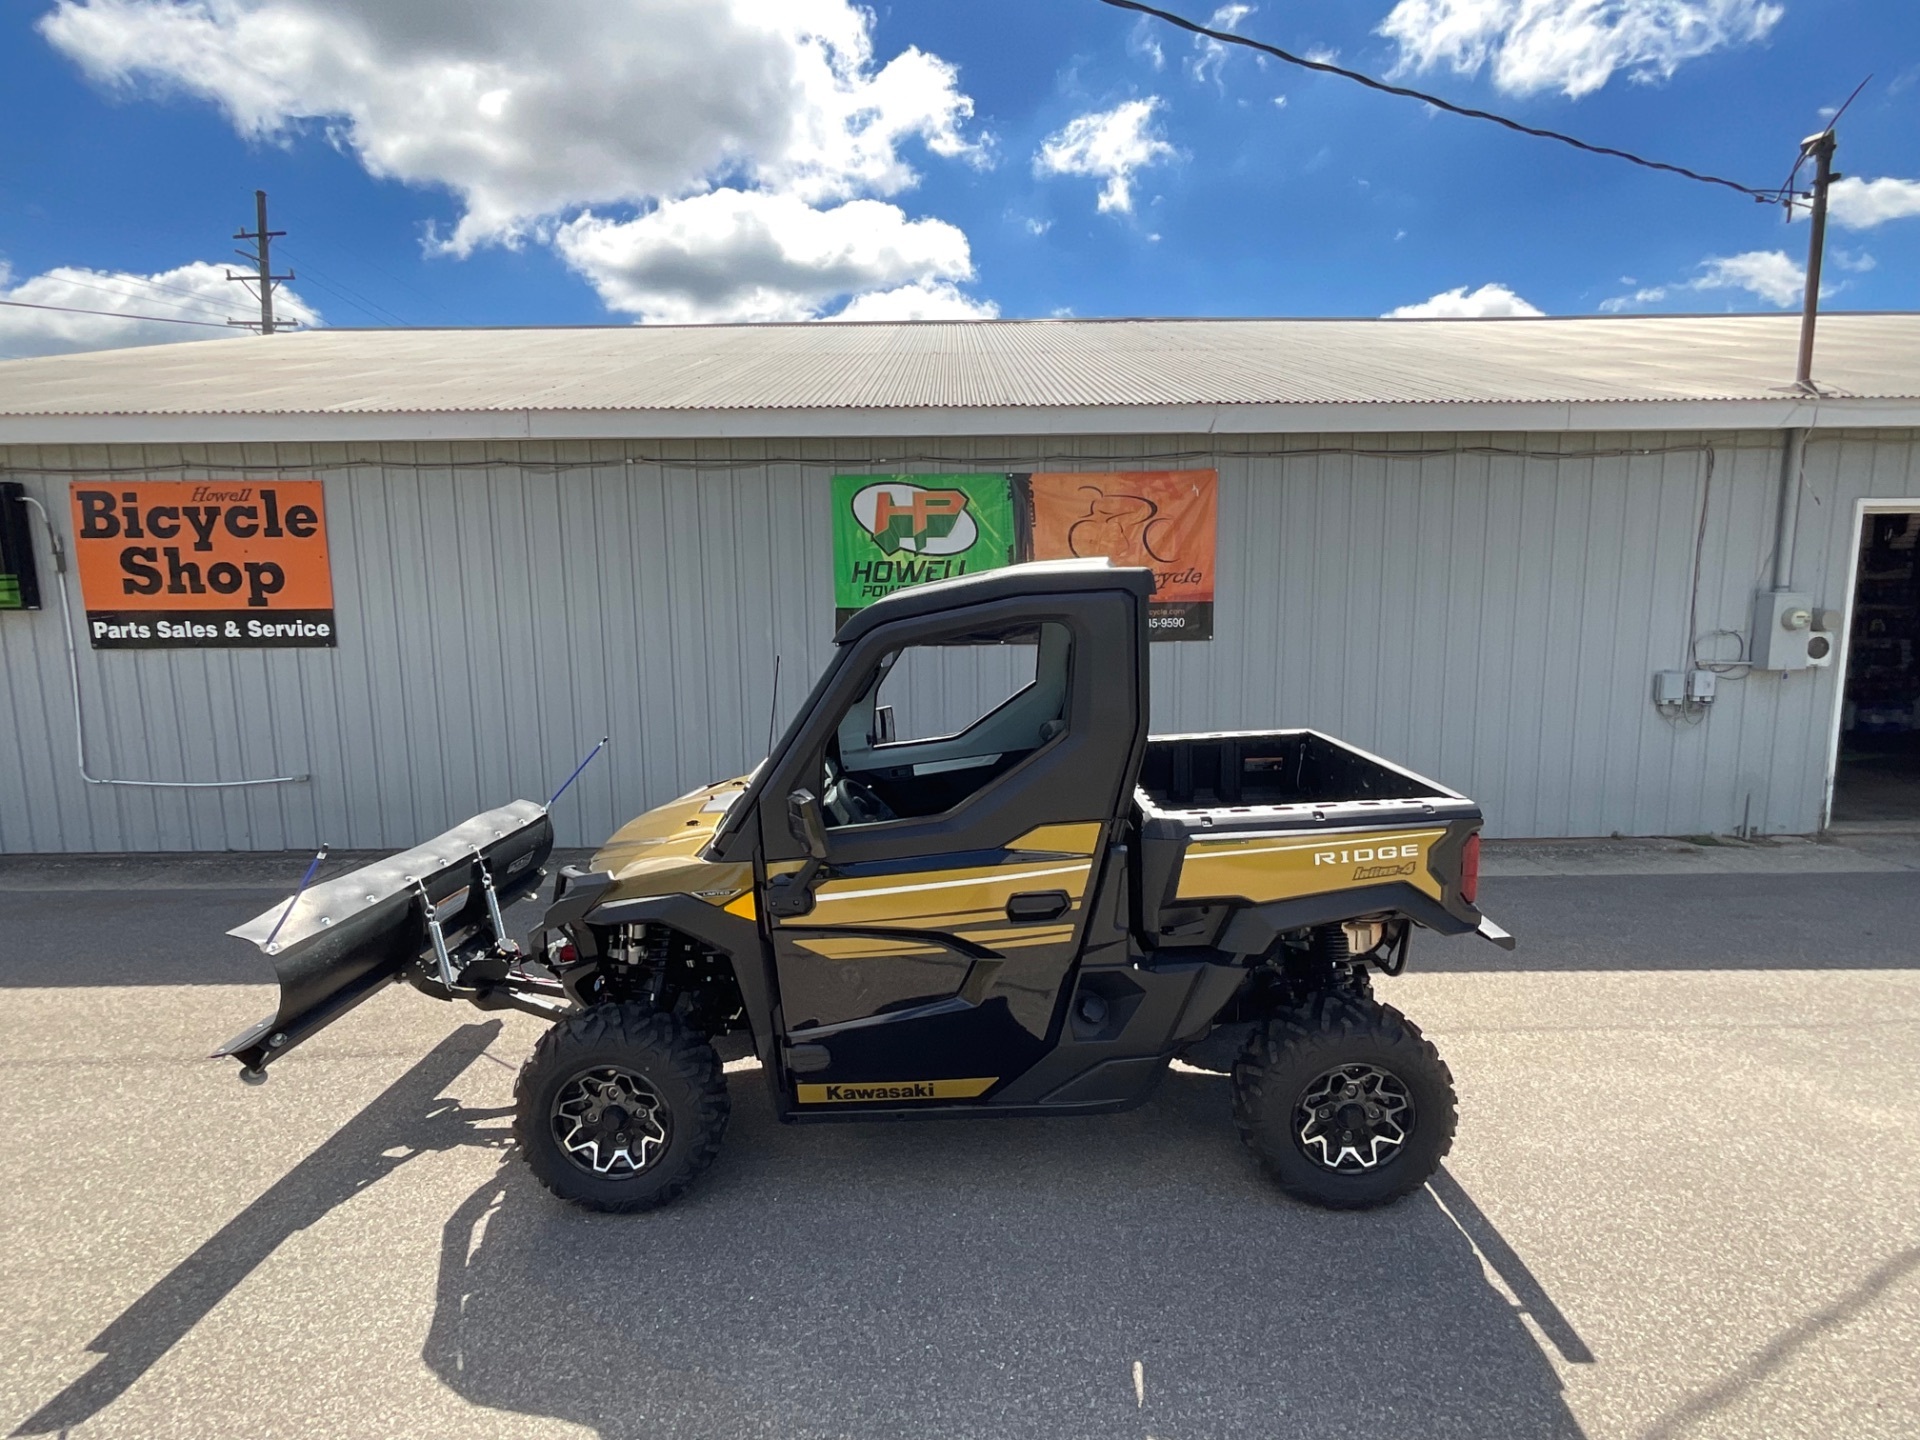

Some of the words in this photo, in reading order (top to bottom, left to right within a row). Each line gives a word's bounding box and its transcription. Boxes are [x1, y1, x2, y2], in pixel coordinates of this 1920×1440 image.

[191, 486, 253, 502] Howell
[76, 488, 318, 551] Bicycle
[874, 490, 966, 546] HP
[119, 546, 286, 606] Shop
[862, 585, 912, 597] POW
[92, 621, 151, 639] Parts
[156, 620, 218, 638] Sales
[224, 620, 242, 638] &
[248, 619, 330, 638] Service
[1314, 844, 1419, 866] RIDGE
[826, 1083, 935, 1100] Kawasaki
